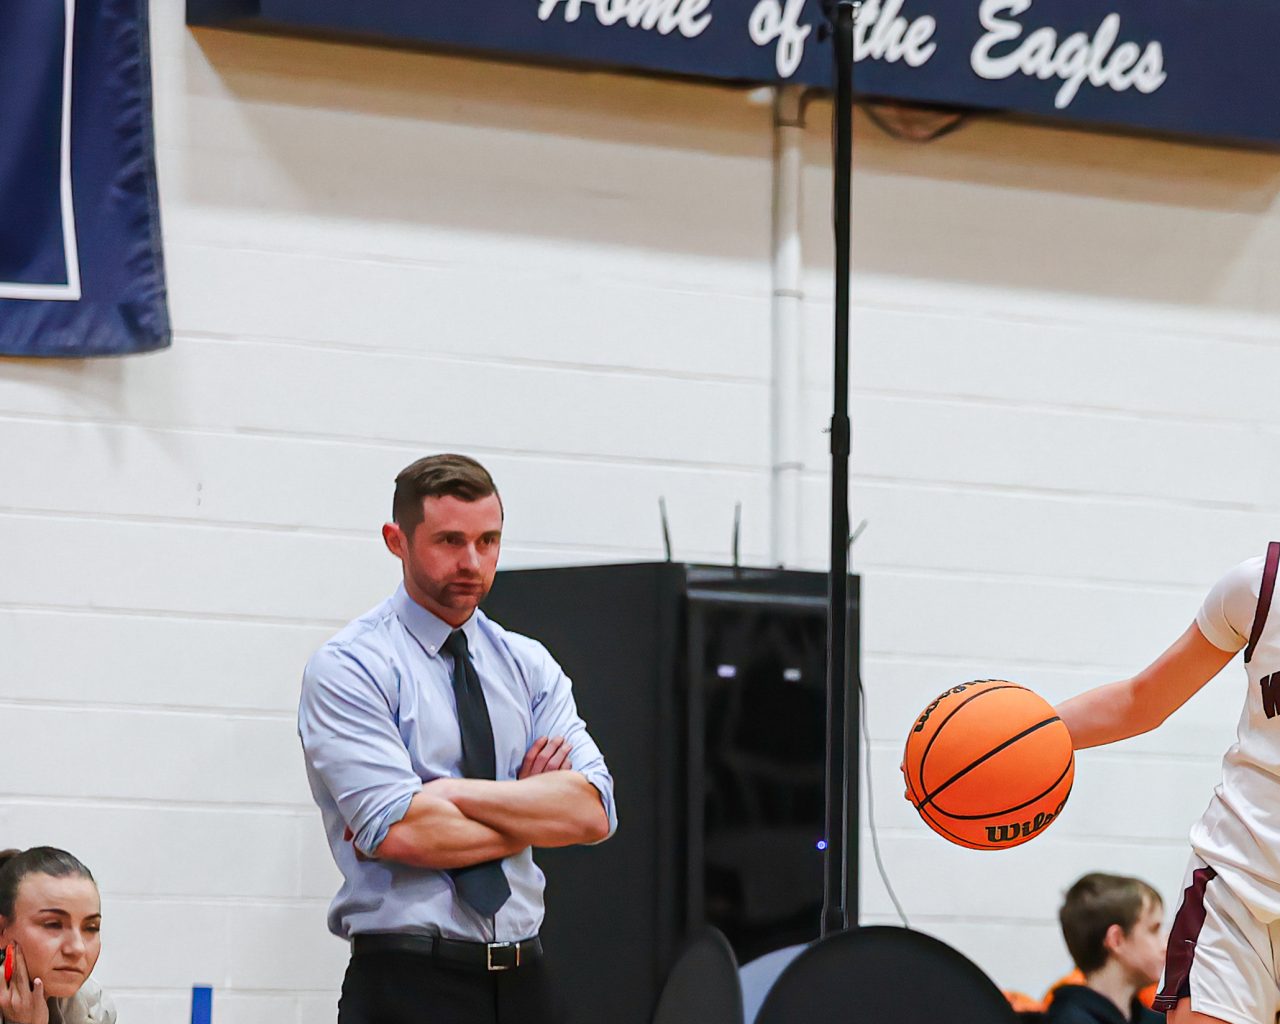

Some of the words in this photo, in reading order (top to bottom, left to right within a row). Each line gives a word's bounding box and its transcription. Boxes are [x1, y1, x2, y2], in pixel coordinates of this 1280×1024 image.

[748, 0, 812, 78] of
[853, 0, 938, 67] the
[970, 0, 1167, 108] Eagles
